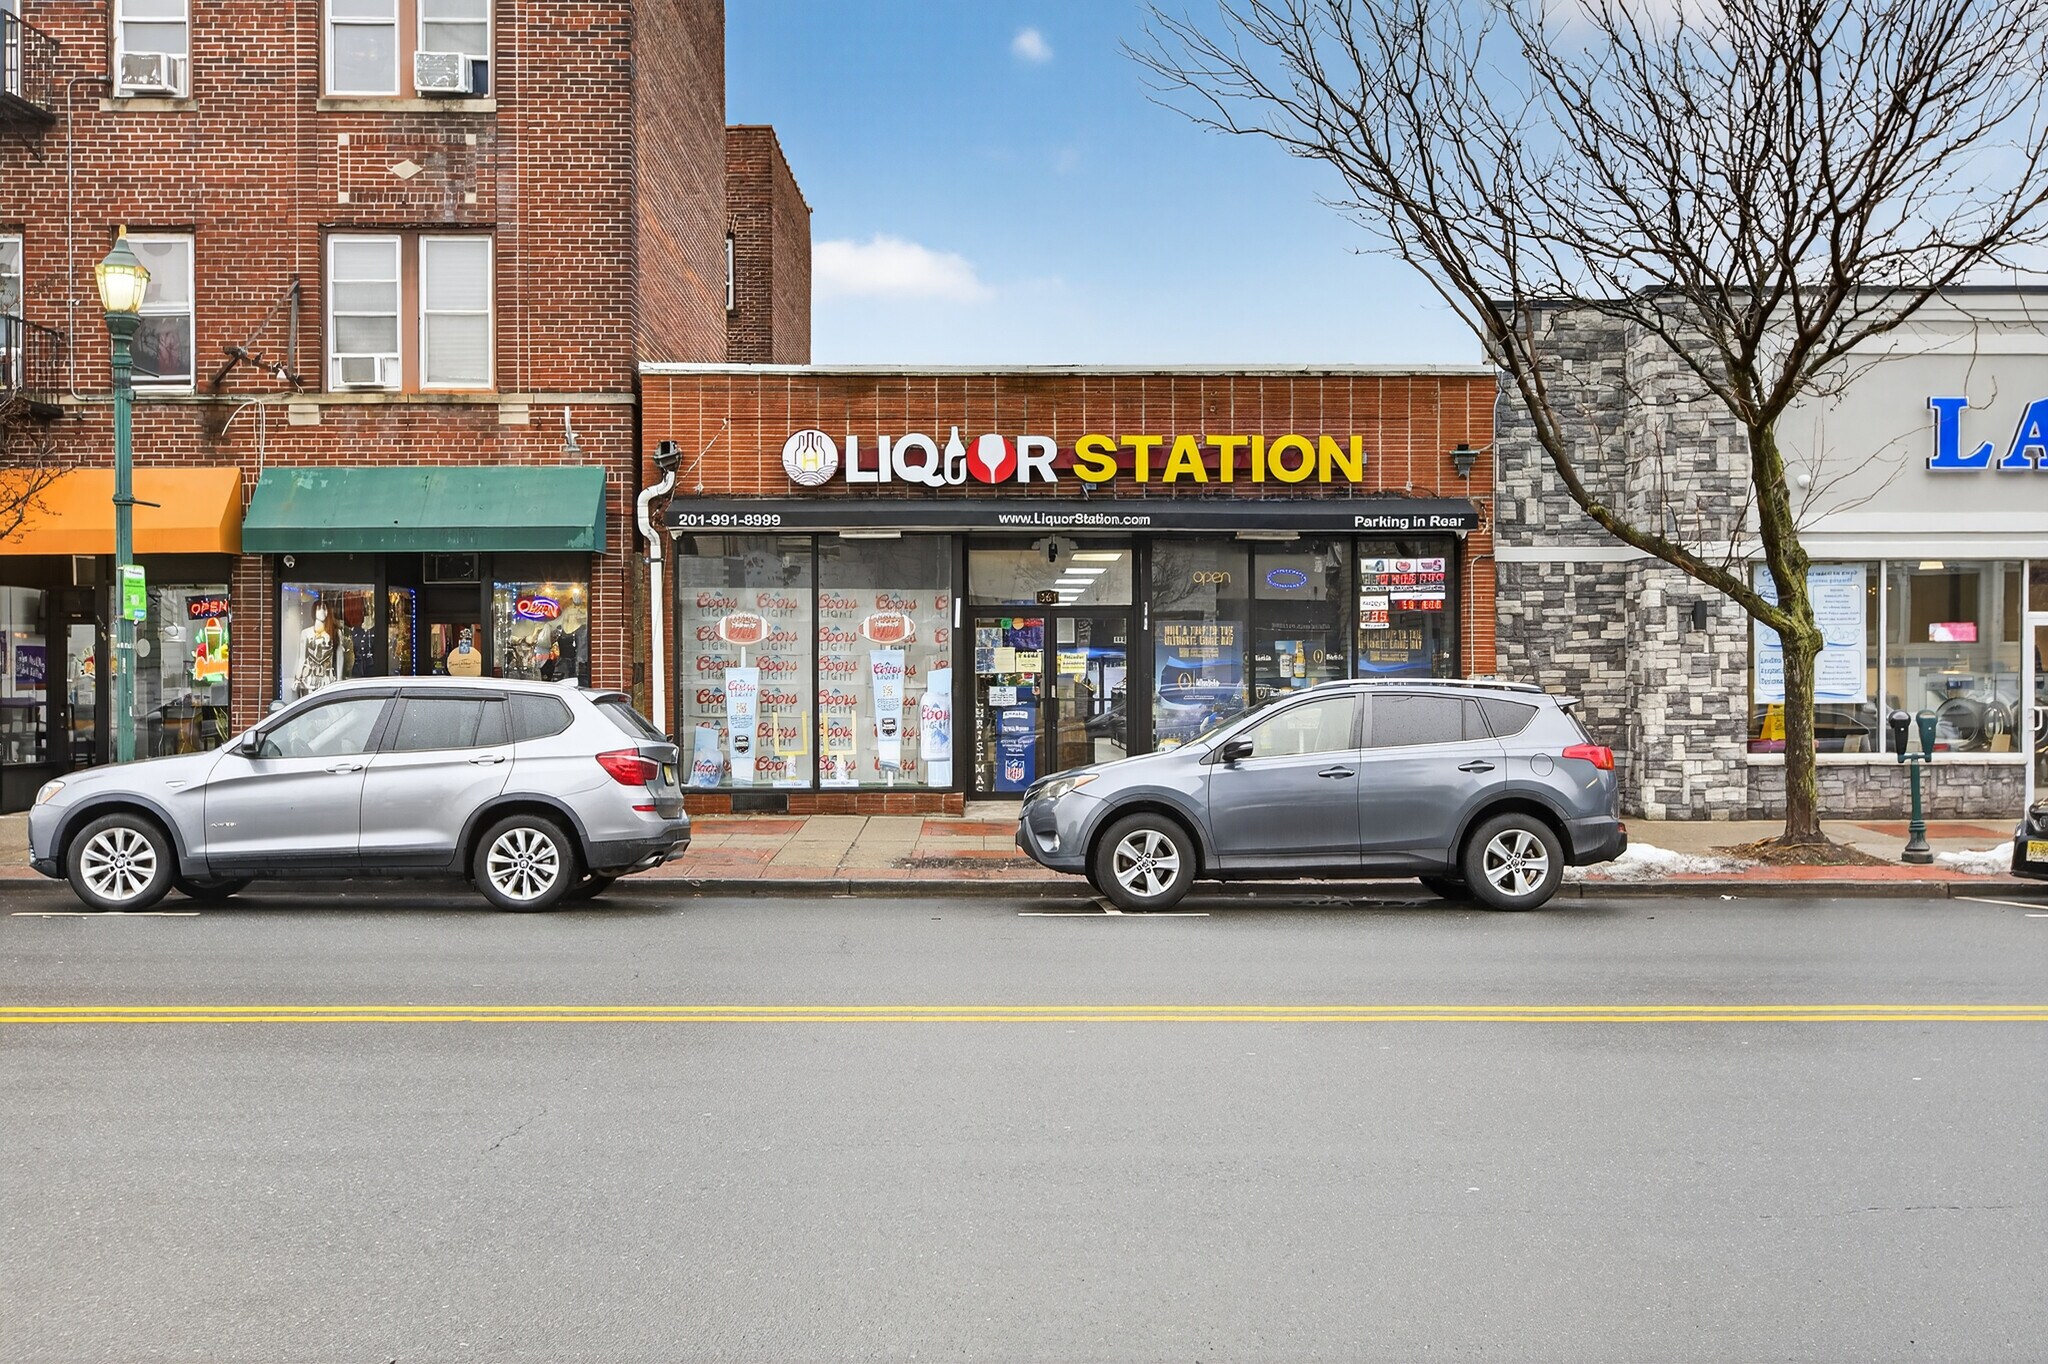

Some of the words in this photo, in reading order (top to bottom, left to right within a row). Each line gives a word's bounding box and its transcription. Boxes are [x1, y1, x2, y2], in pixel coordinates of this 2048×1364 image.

[845, 426, 1059, 487] LIQUOR
[1072, 433, 1363, 483] STATION
[678, 513, 781, 527] 201-991-8999
[998, 512, 1151, 527] www.LiquorStation.com
[1354, 515, 1409, 530] Parking
[1413, 515, 1426, 528] in
[1429, 515, 1465, 527] Rear
[1192, 571, 1231, 586] open
[191, 600, 228, 616] OPEN
[696, 591, 738, 609] Coors
[756, 592, 798, 610] Coors
[819, 593, 858, 610] Coors
[876, 593, 917, 610] Coors
[517, 600, 558, 618] OPEN
[821, 609, 853, 619] LIGHT
[819, 626, 858, 643] Coors
[821, 643, 853, 652] LIGHT
[756, 655, 798, 671] Coors
[818, 656, 858, 672] Coors
[821, 672, 853, 681] LIGHT
[696, 688, 727, 705] Coo
[819, 689, 858, 705] Coors
